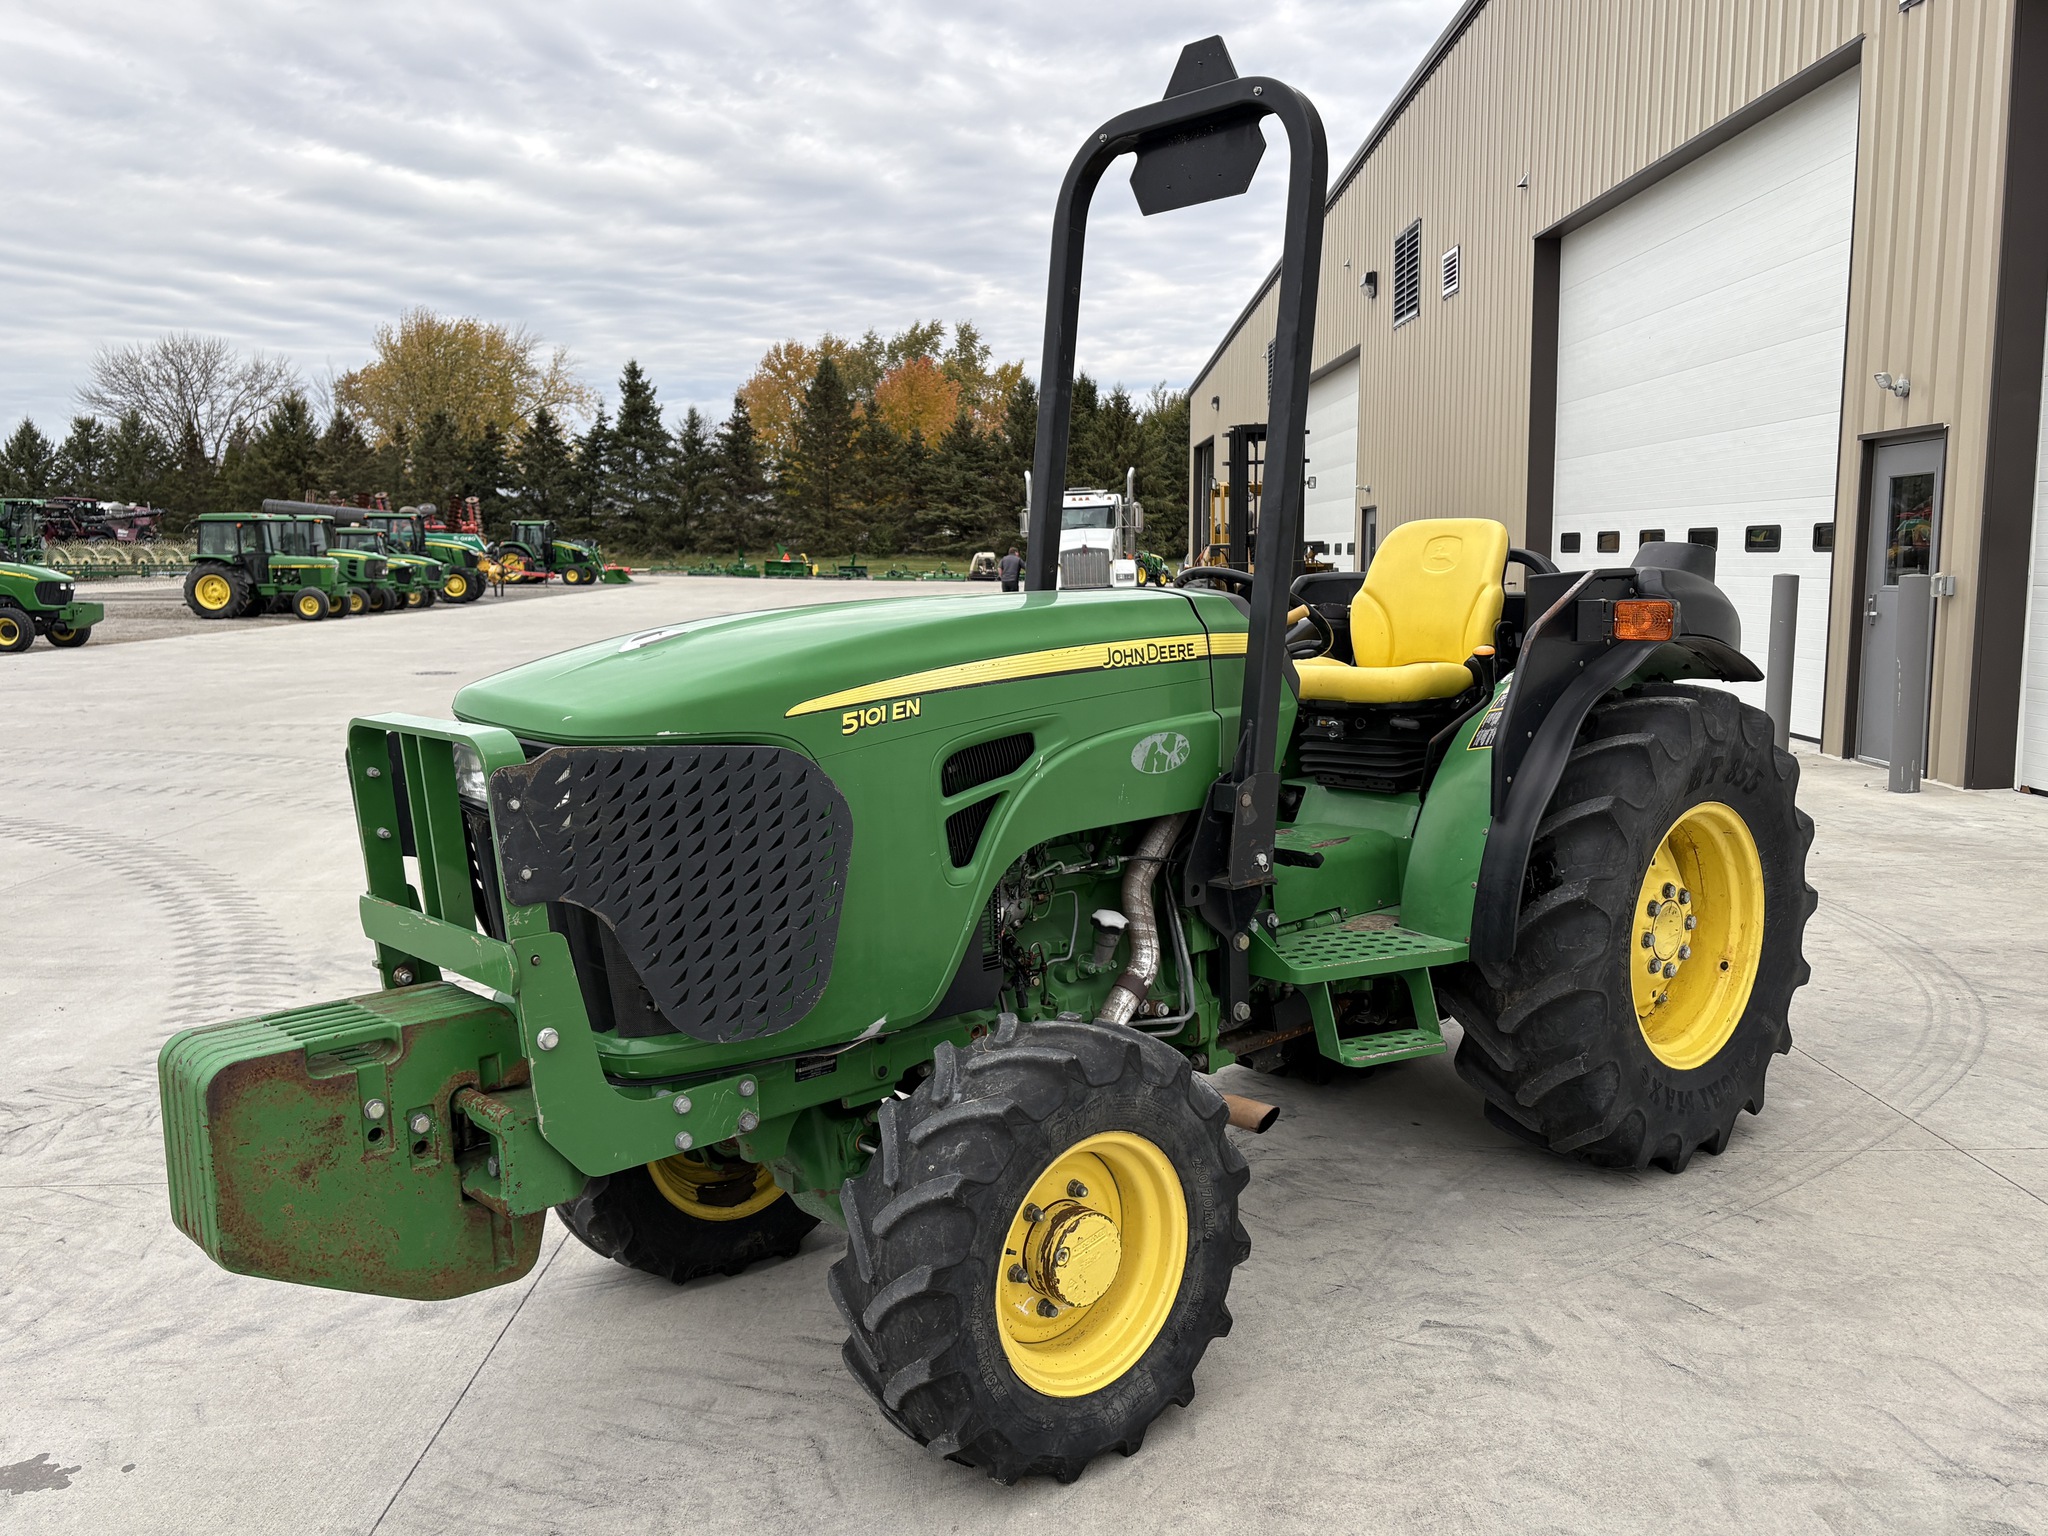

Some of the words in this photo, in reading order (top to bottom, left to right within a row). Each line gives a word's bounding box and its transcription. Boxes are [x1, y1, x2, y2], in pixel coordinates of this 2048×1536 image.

[1103, 647, 1146, 669] JOHN
[1147, 643, 1197, 662] DEERE
[842, 706, 888, 736] 5101
[892, 698, 921, 722] EN
